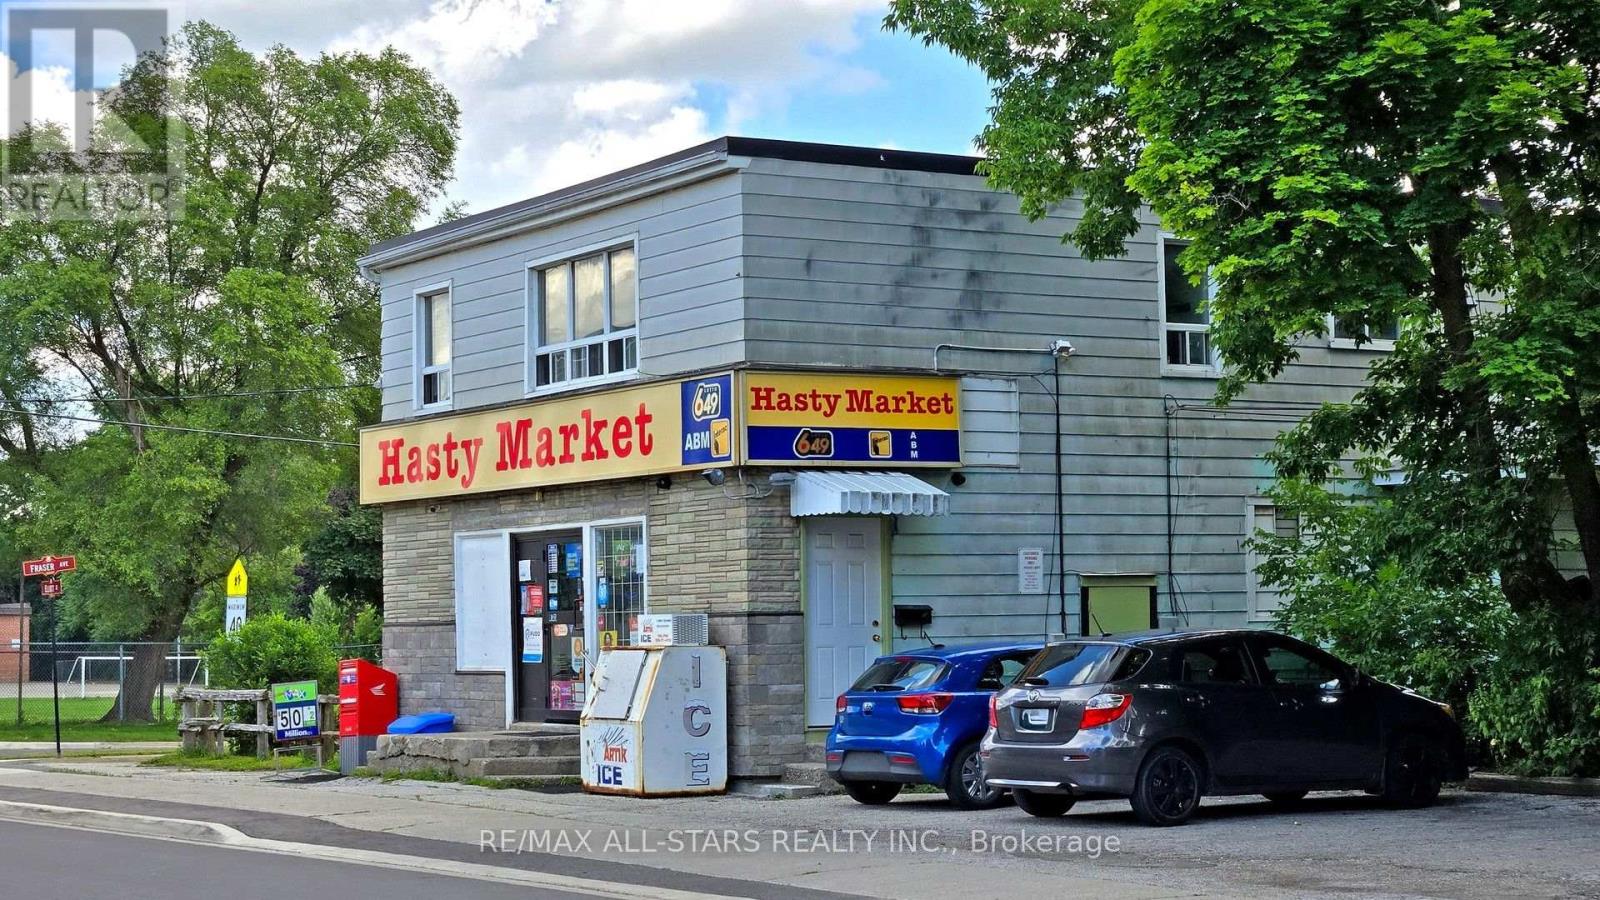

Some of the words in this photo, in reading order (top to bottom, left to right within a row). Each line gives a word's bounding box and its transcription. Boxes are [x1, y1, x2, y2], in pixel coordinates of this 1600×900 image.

[695, 387, 718, 416] 649
[751, 387, 842, 417] Hasty
[845, 389, 954, 414] Market
[378, 431, 483, 488] Hasty
[496, 402, 653, 472] Market
[685, 431, 710, 451] ABM
[797, 432, 830, 454] 649
[30, 563, 54, 573] FRASER
[641, 635, 651, 643] ICE
[597, 764, 623, 785] ICE
